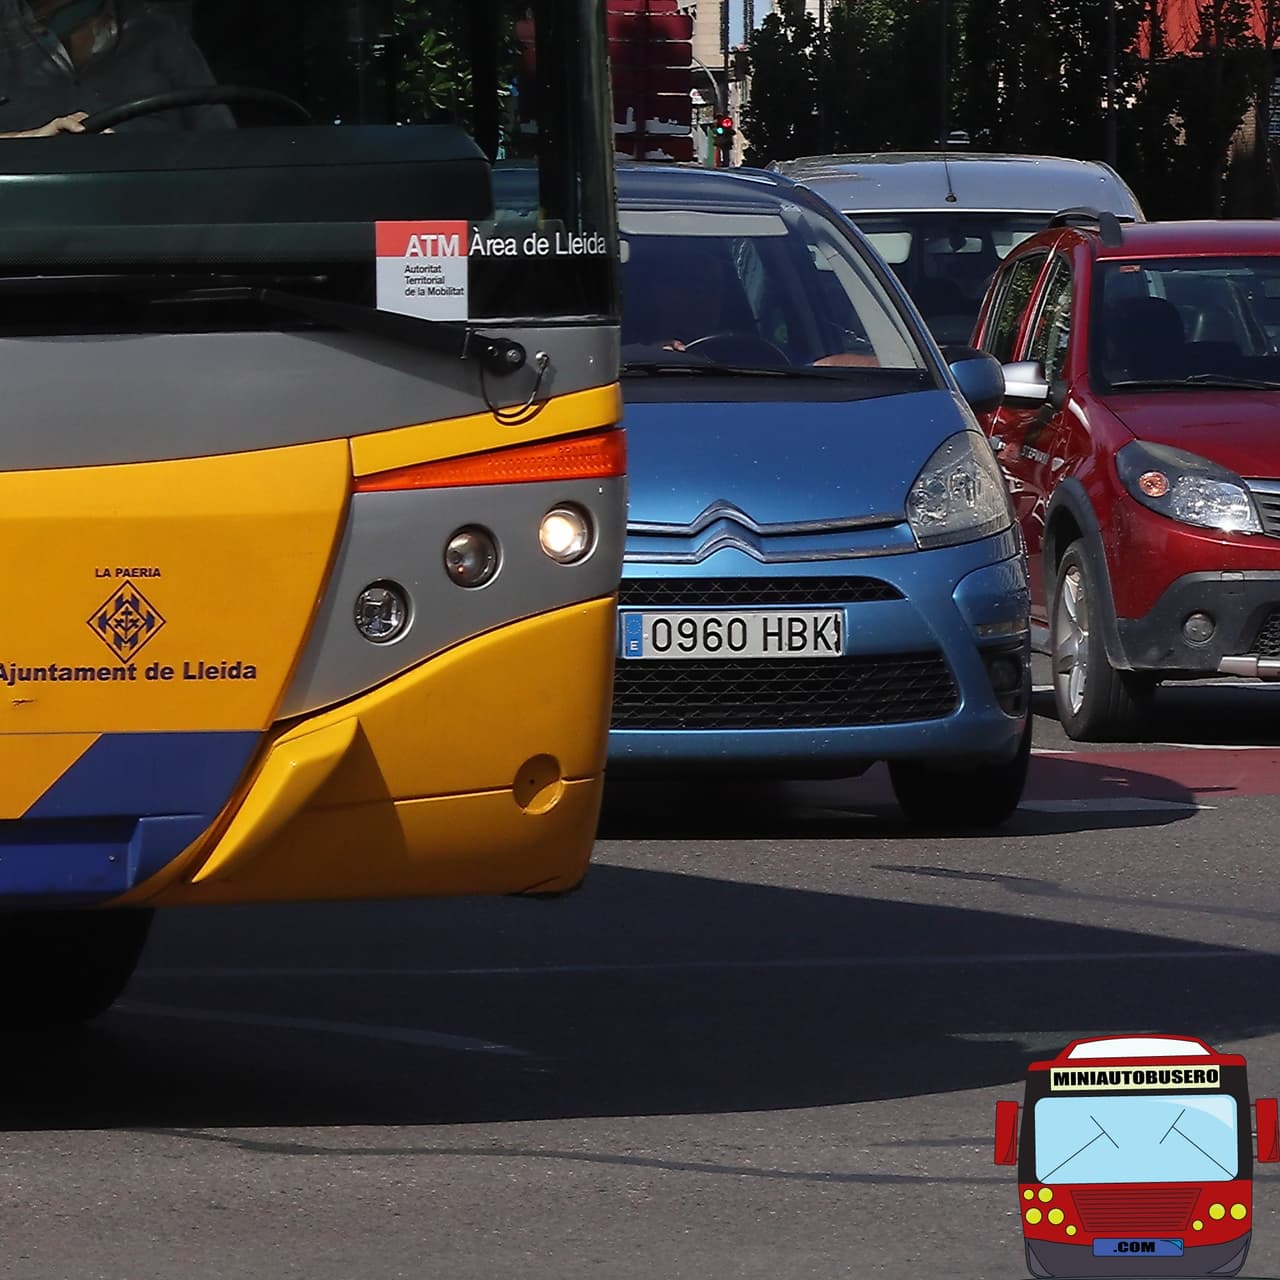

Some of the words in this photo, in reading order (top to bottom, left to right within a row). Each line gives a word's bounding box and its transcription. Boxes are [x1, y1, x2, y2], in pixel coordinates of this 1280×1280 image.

[405, 234, 460, 257] ATM
[469, 227, 517, 256] Àrea
[523, 233, 549, 256] de
[555, 231, 608, 255] Lleida
[404, 265, 442, 273] Autoritat
[404, 276, 445, 285] Territorial
[404, 287, 416, 296] de
[418, 287, 425, 296] la
[427, 287, 464, 296] Mobilitat
[95, 568, 111, 578] LA
[115, 568, 161, 578] PAERIA
[652, 617, 747, 652] 0960
[762, 616, 834, 652] HBK
[630, 640, 638, 650] E
[144, 662, 175, 681] de
[183, 661, 257, 680] Lleida
